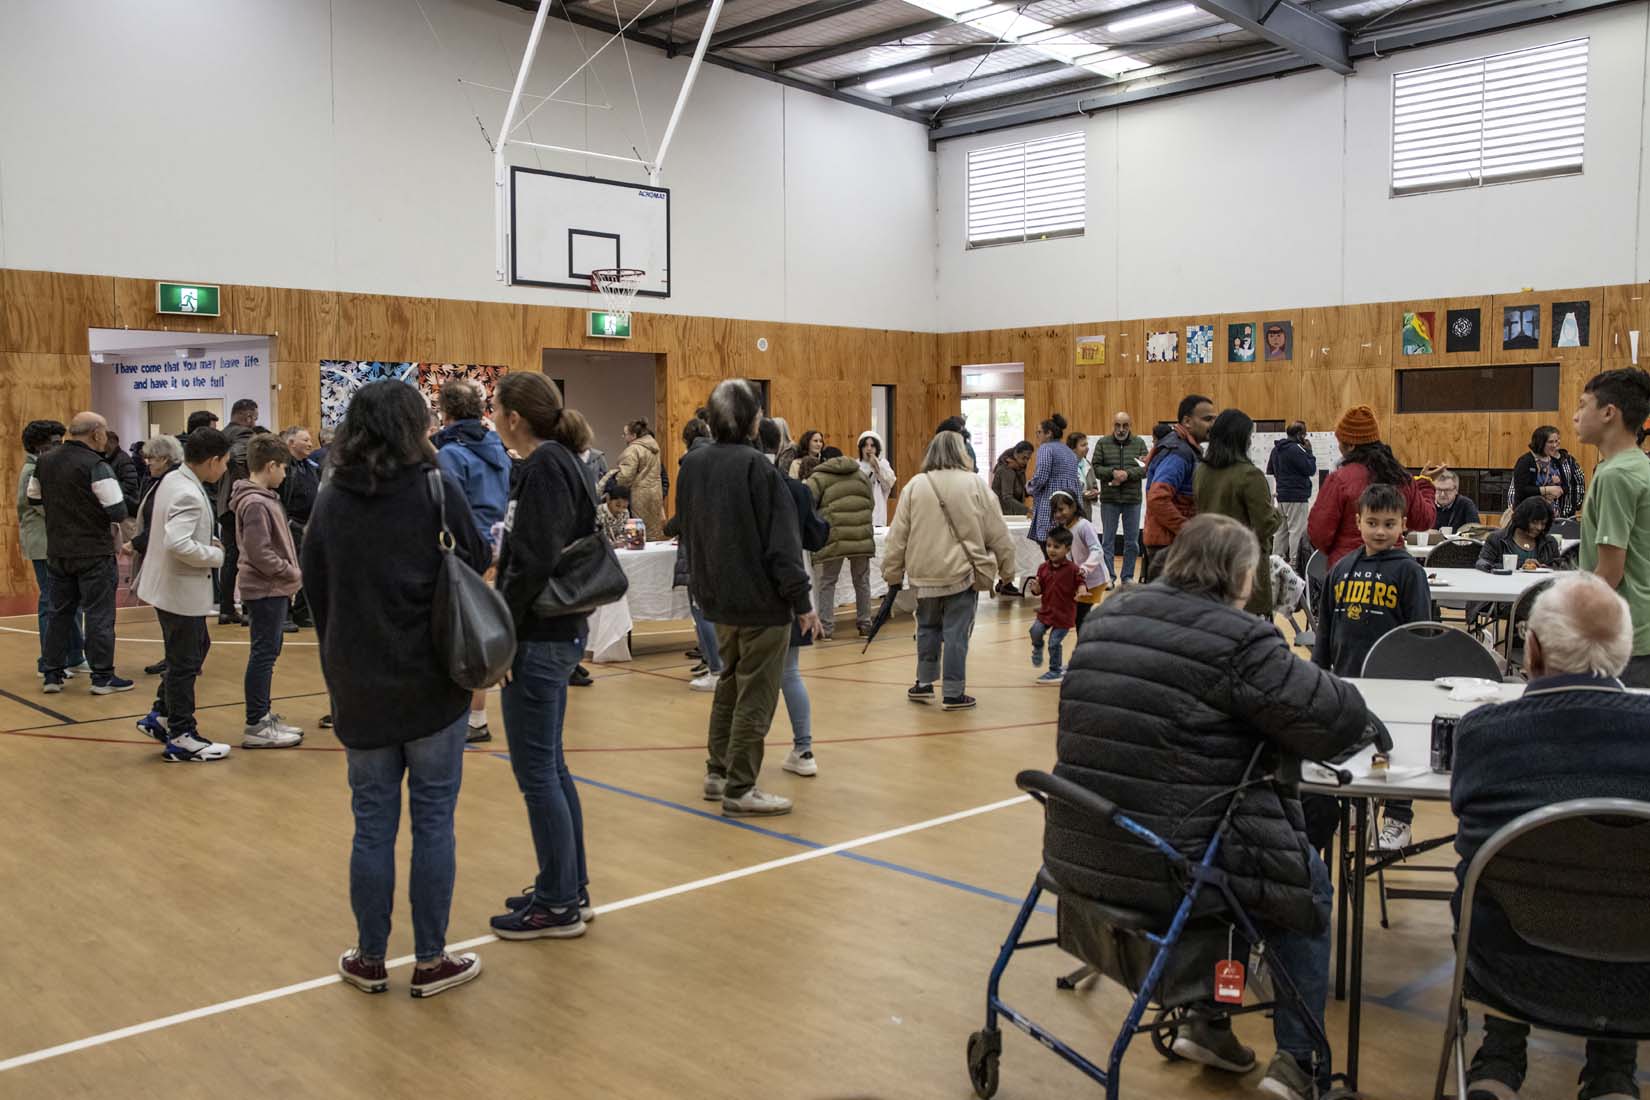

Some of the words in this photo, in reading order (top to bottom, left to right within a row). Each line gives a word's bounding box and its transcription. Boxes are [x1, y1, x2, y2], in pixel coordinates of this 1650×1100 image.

[120, 362, 138, 373] have
[141, 364, 161, 373] come
[164, 361, 179, 372] that
[199, 360, 216, 370] may
[220, 356, 240, 368] have
[133, 378, 147, 389] and
[150, 378, 168, 389] have
[171, 376, 177, 388] it
[181, 378, 190, 388] to
[193, 376, 206, 387] the
